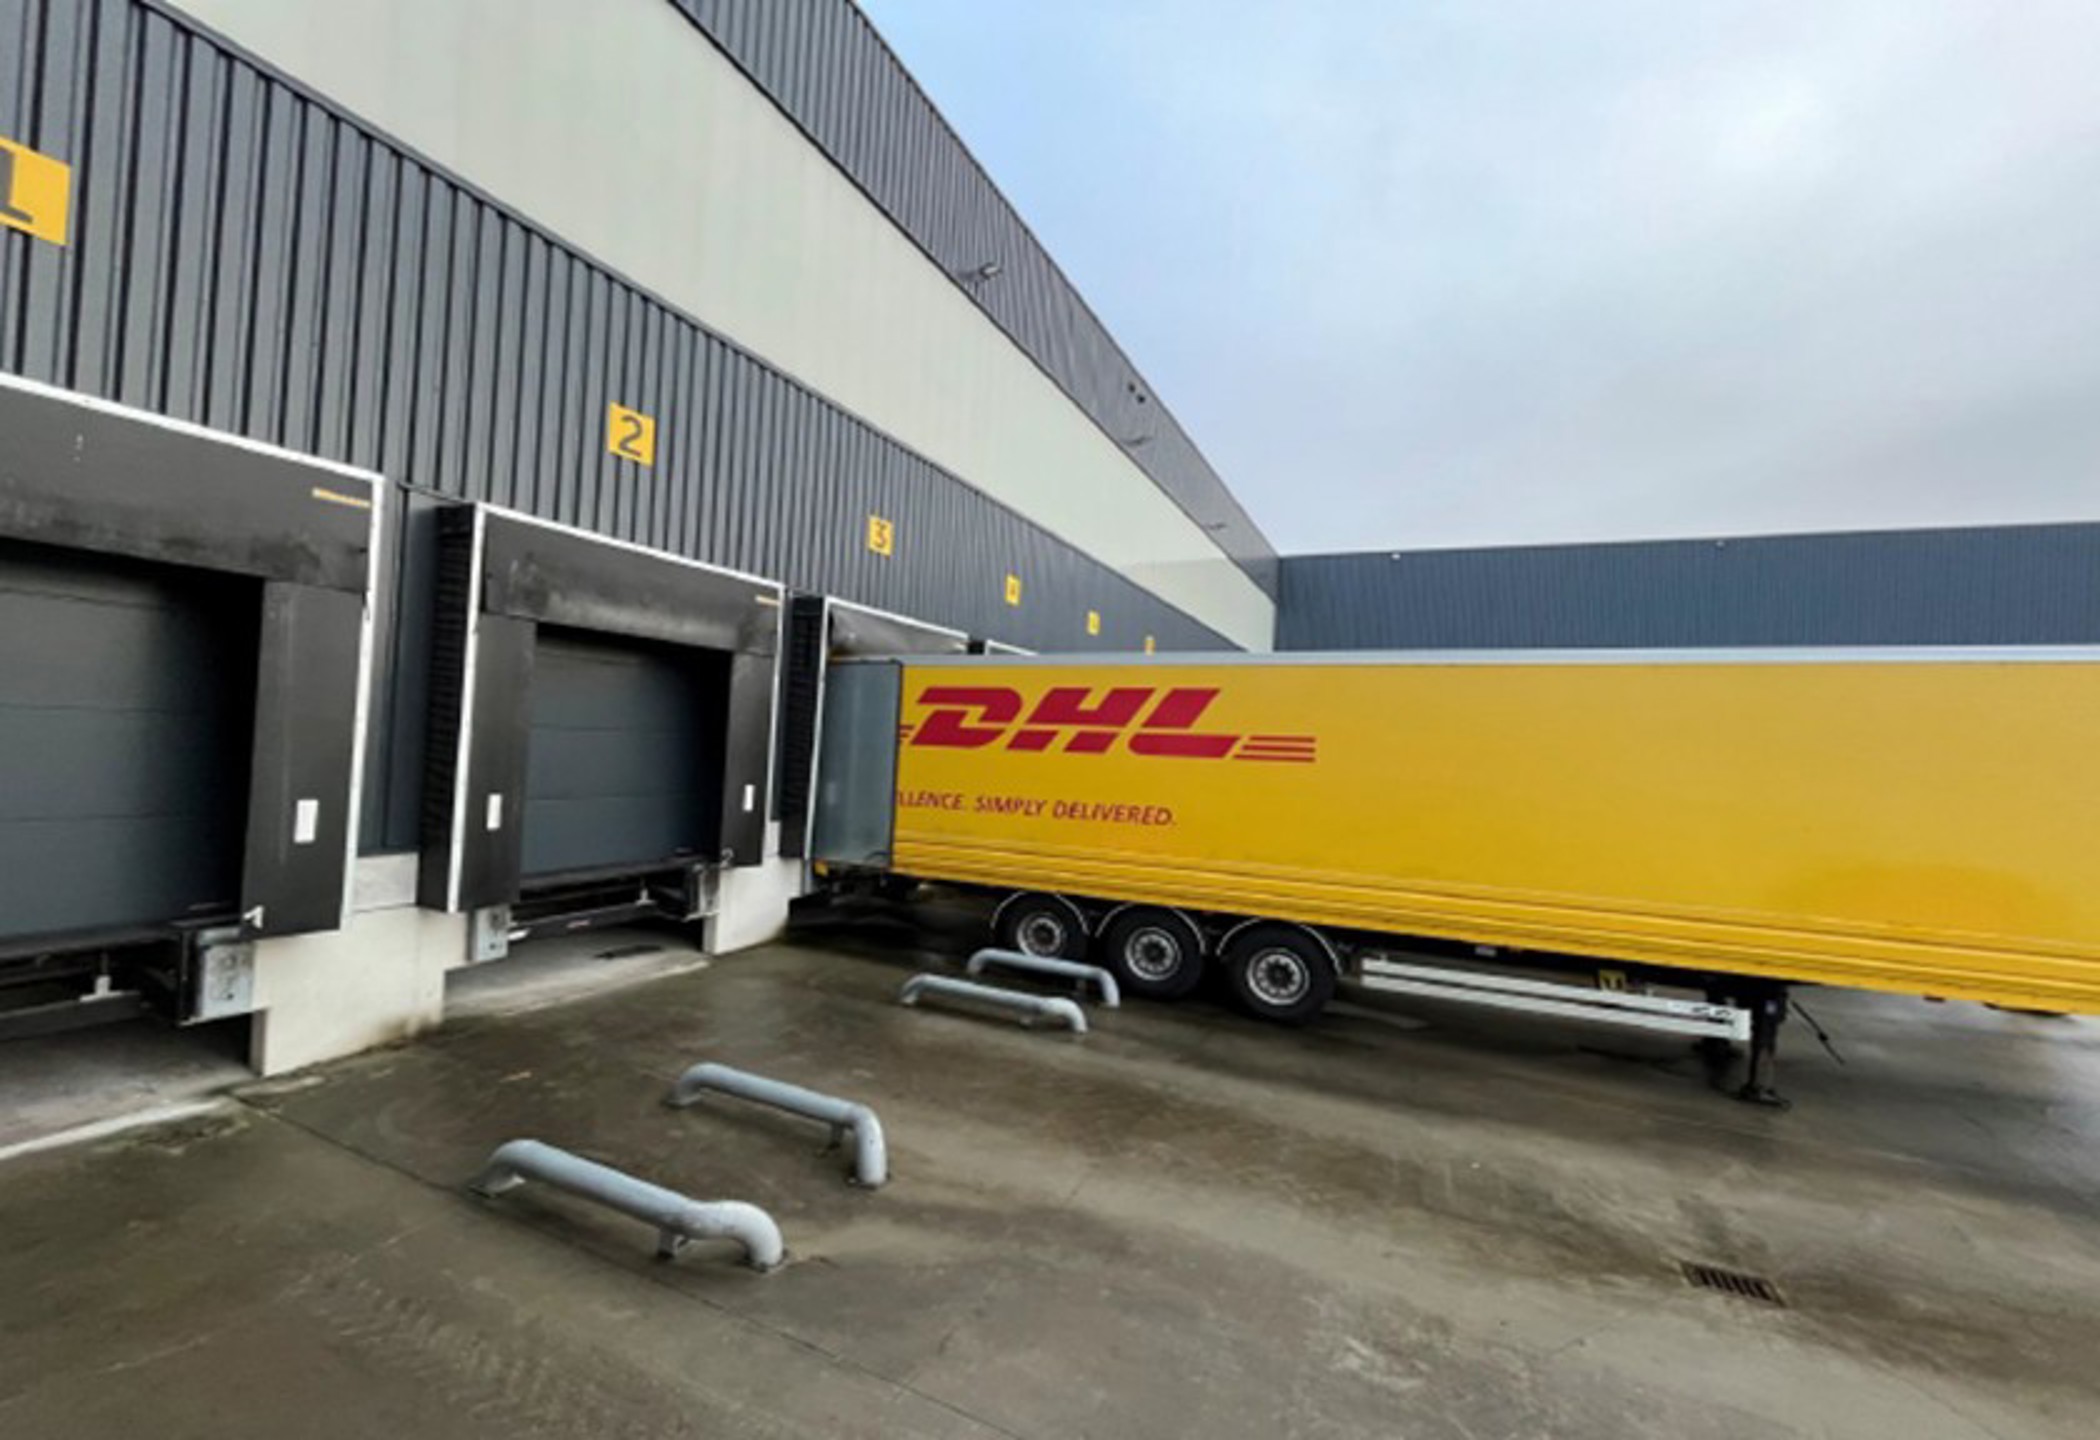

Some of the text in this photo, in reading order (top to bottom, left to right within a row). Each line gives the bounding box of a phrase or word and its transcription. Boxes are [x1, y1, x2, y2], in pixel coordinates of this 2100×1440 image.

[619, 415, 643, 457] 2
[873, 521, 889, 549] 3
[911, 686, 1240, 758] DHL
[974, 795, 1047, 816] SIMPLY
[1052, 799, 1178, 826] DELIVERED.
